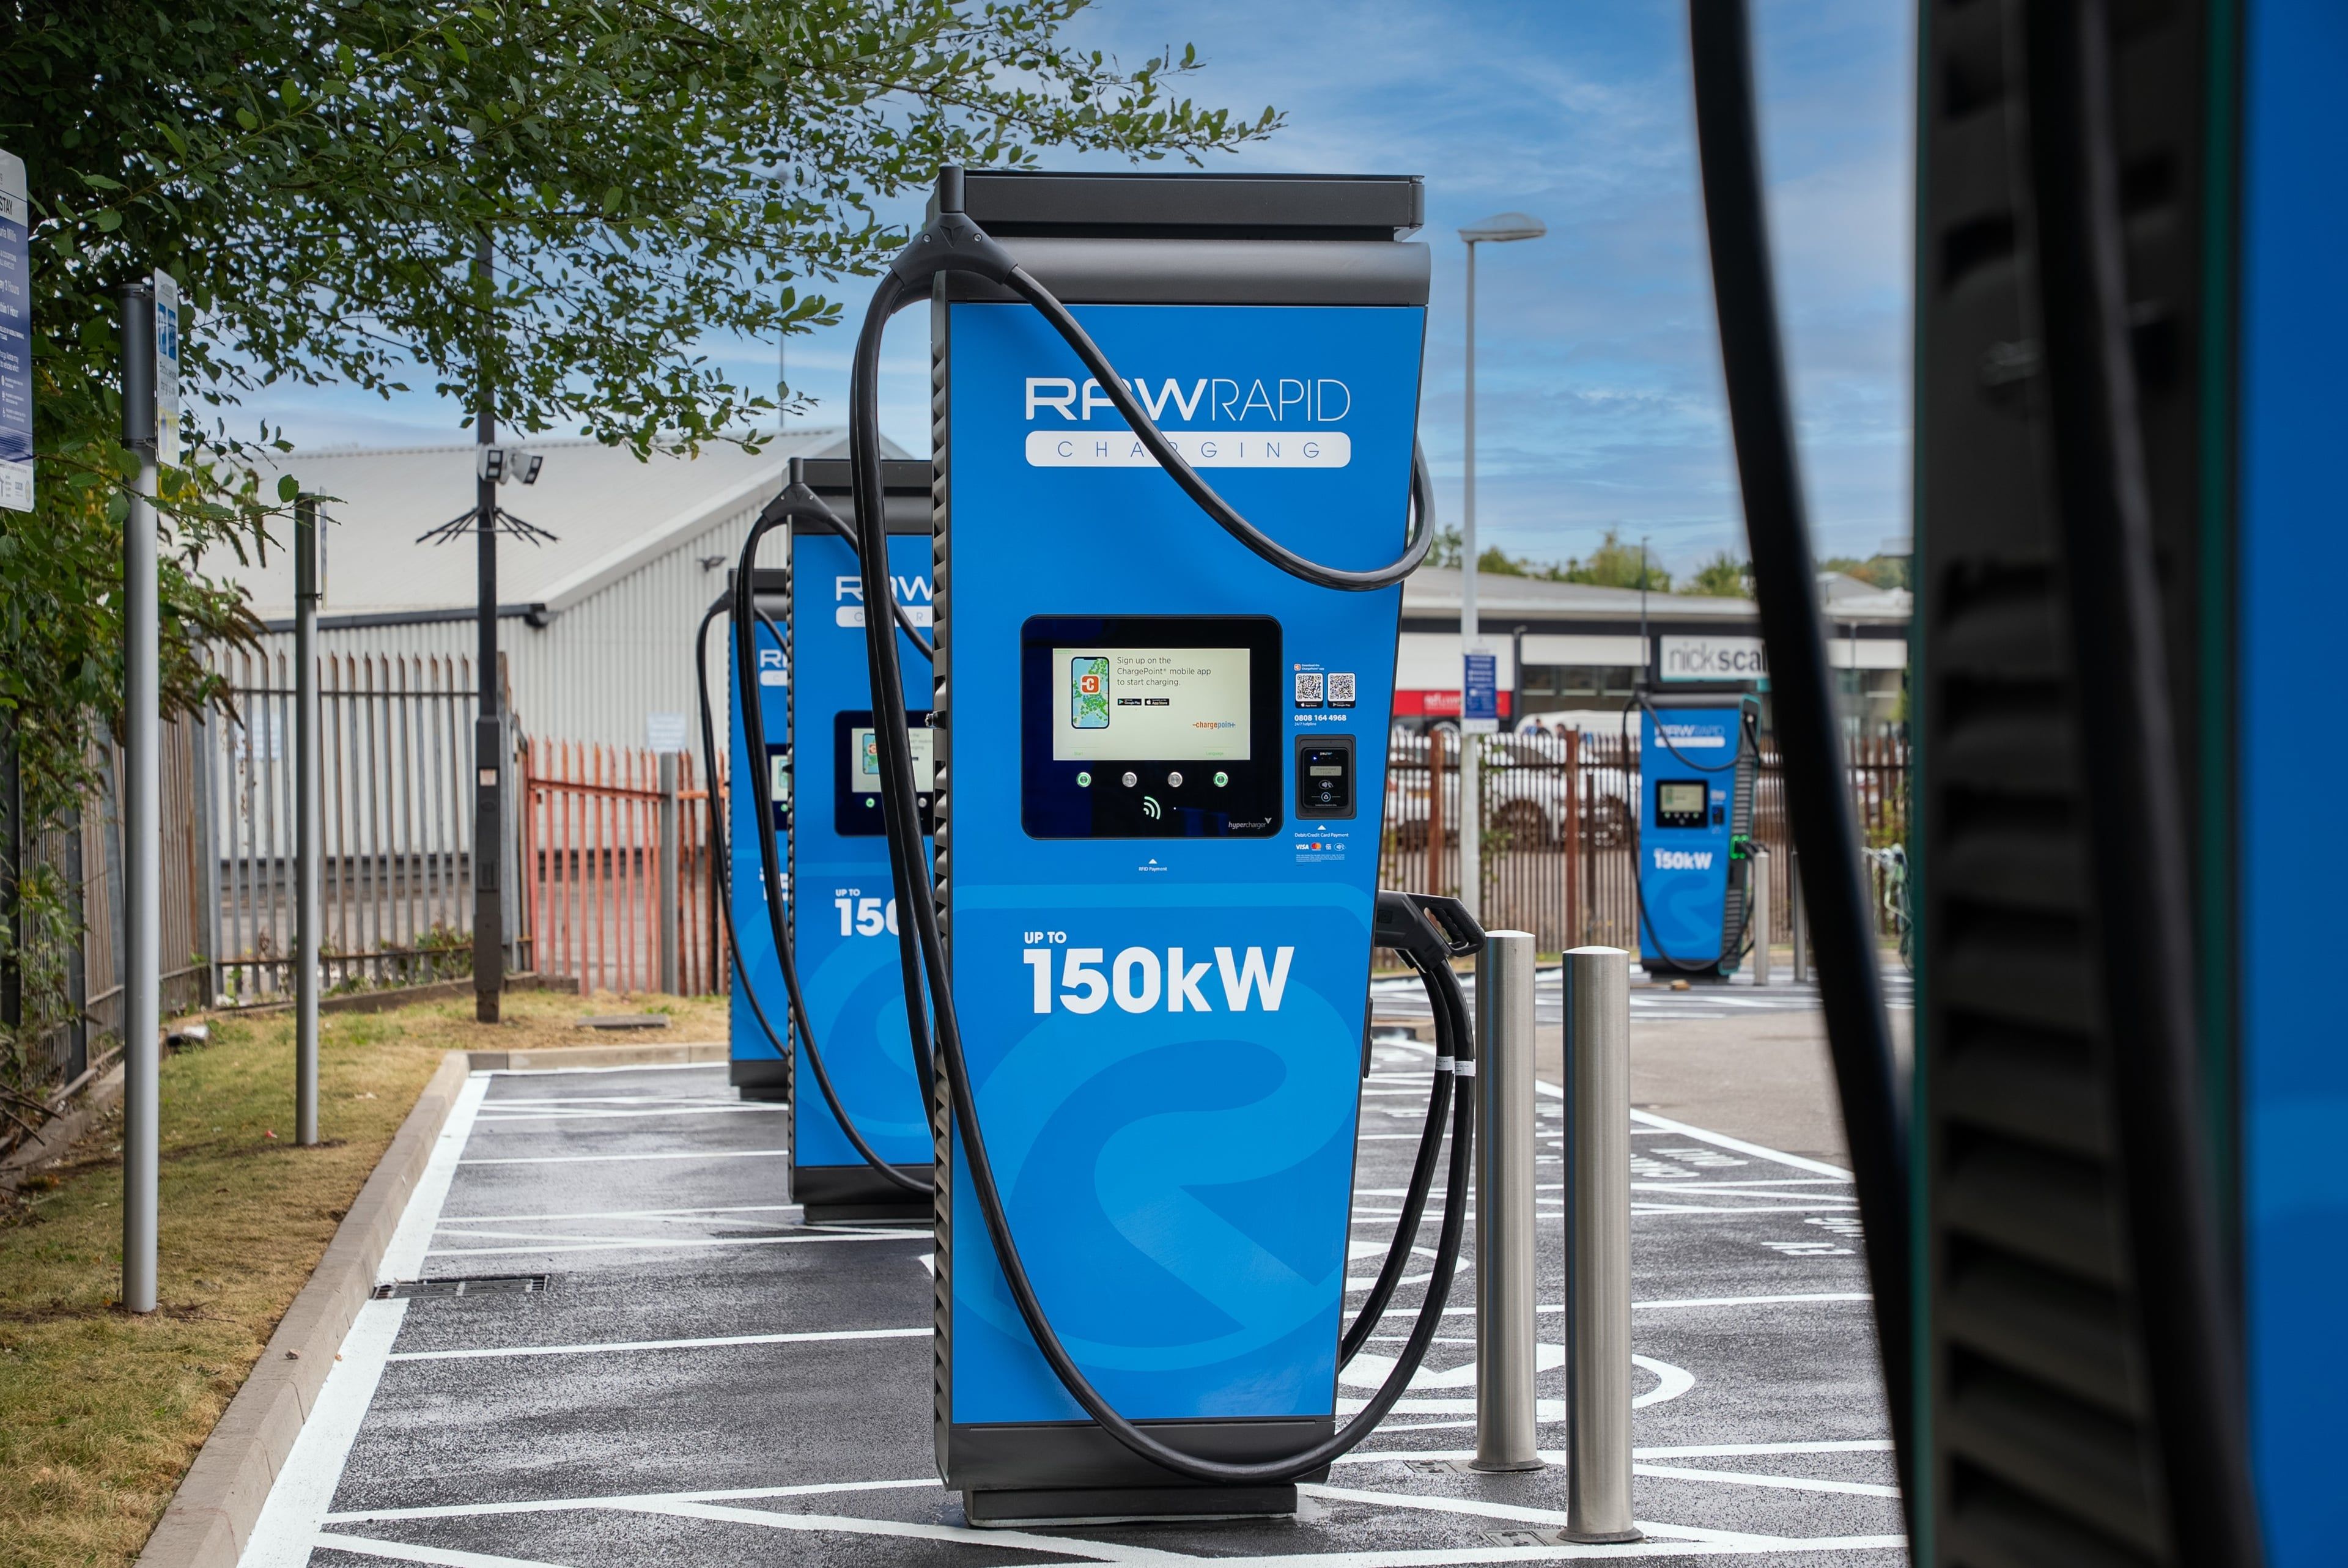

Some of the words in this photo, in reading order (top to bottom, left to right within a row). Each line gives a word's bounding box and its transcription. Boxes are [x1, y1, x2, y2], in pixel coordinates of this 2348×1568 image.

[1058, 441, 1320, 458] CHAGING
[1654, 852, 1712, 870] 150kW
[1024, 931, 1043, 944] UP
[1047, 931, 1066, 944] TO
[1023, 946, 1295, 1014] 150kW
